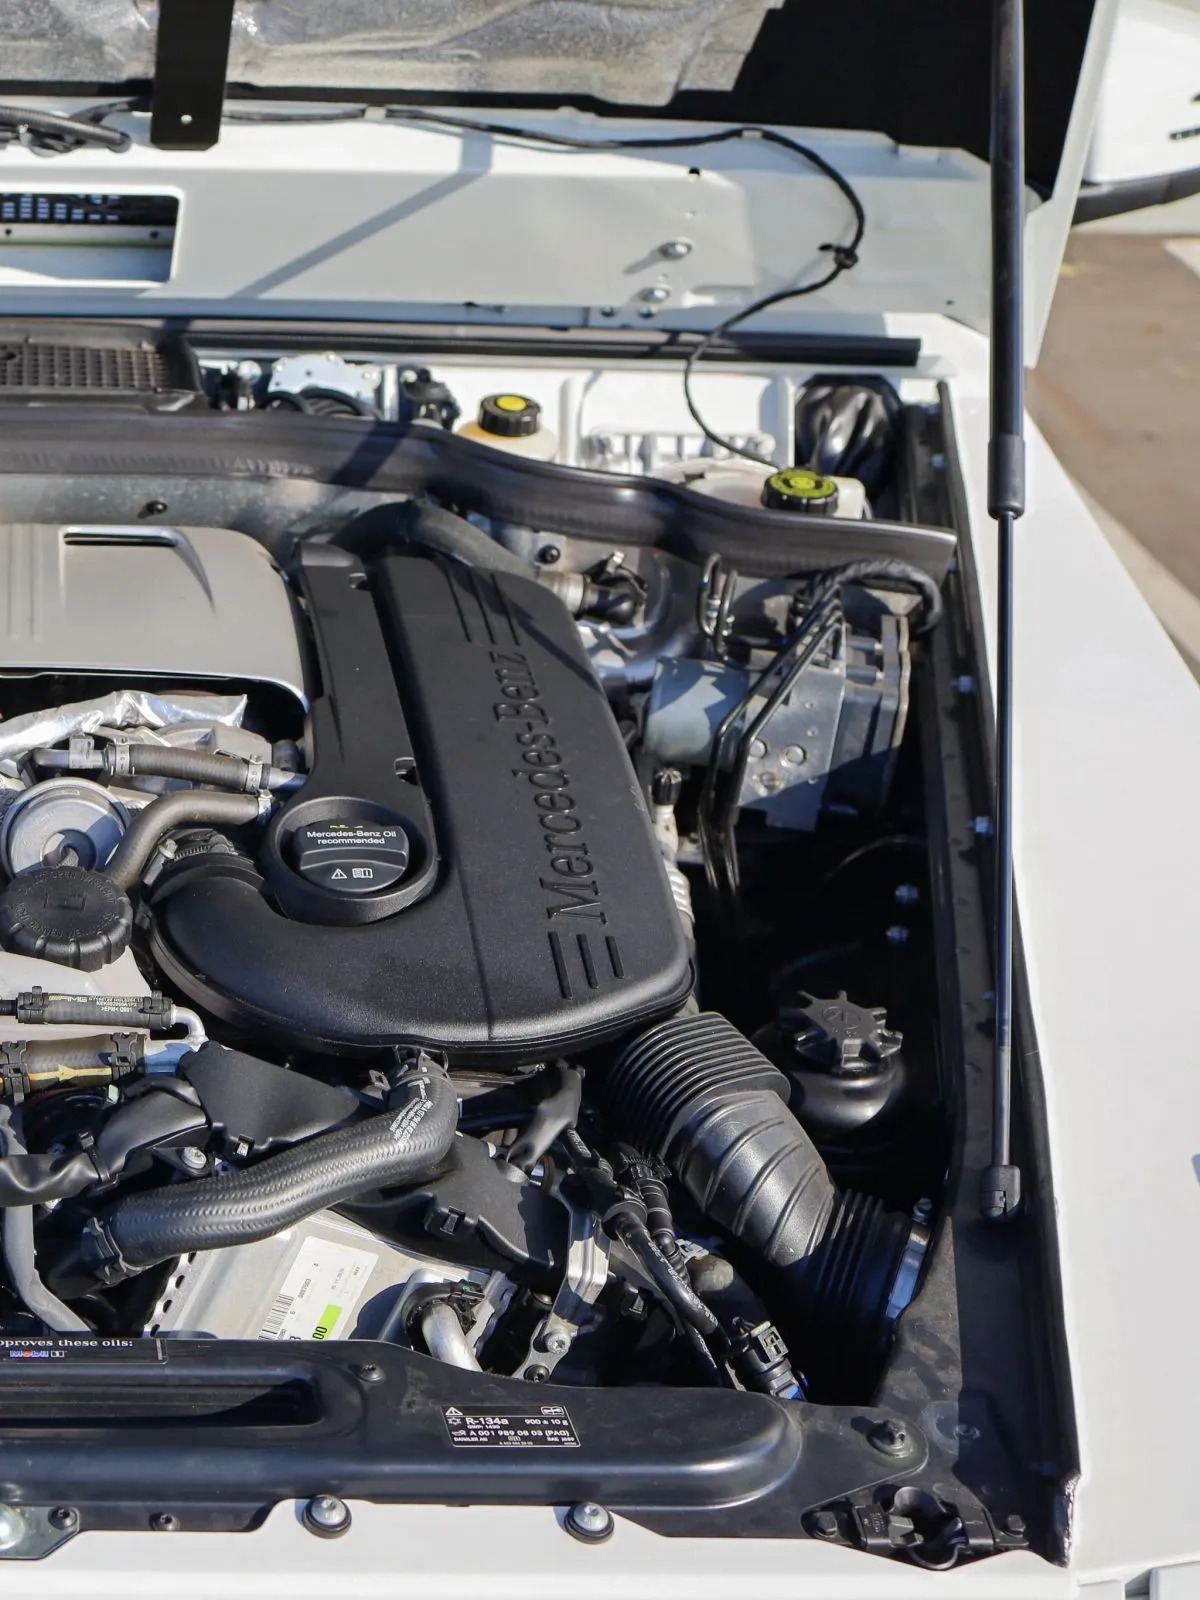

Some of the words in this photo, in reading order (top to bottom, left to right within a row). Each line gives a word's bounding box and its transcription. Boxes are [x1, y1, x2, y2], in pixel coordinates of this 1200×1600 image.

[489, 651, 608, 924] Mercedes-Benz
[58, 1338, 99, 1347] these
[102, 1338, 133, 1347] oils:
